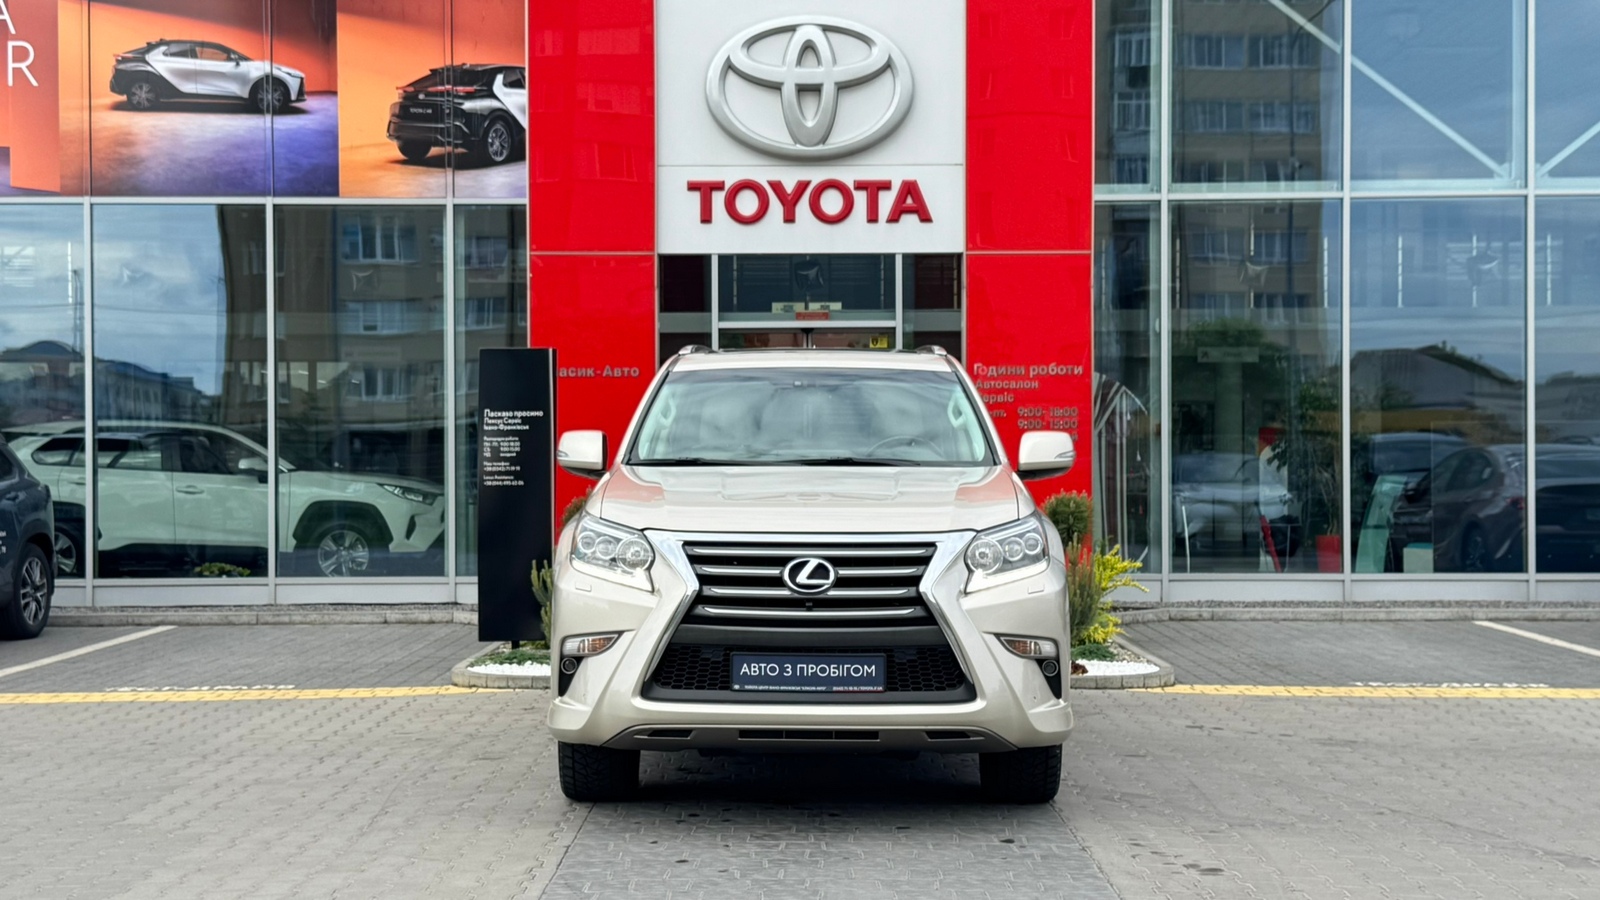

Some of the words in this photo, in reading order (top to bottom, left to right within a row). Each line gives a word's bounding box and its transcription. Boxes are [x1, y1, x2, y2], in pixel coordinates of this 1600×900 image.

[687, 178, 933, 224] TOYOTA
[557, 364, 639, 378] асик-Авто
[973, 362, 1025, 377] Години
[1029, 362, 1083, 378] роботи
[976, 380, 1039, 389] Автосалон
[980, 391, 1014, 403] ервіс
[740, 663, 779, 676] АВТО
[783, 664, 793, 676] З
[796, 664, 876, 677] ПРОБІГОМ
